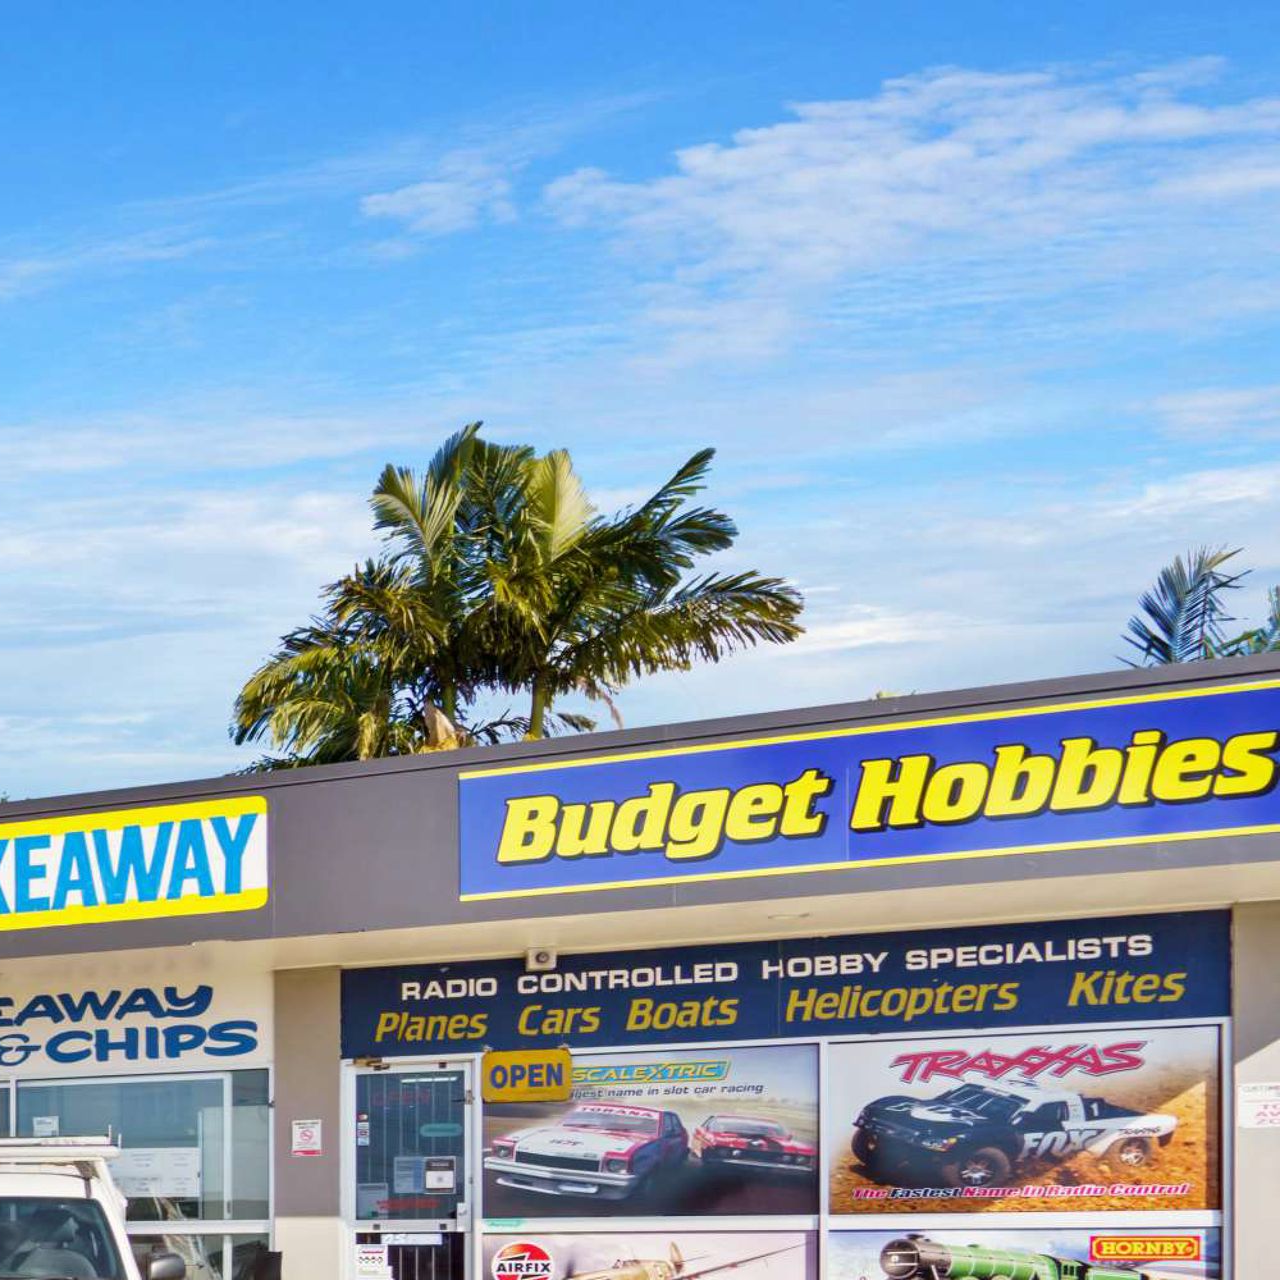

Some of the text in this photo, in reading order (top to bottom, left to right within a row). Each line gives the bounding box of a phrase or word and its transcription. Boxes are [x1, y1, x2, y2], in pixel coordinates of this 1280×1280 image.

[496, 729, 1279, 864] Budget Hobbies
[401, 934, 1154, 1001] RADIO CONTROLLED HOBBY SPECIALISTS
[375, 969, 1187, 1042] Planes Cars Boats Helicopters Kites
[45, 1020, 259, 1062] CHIPS
[572, 1060, 720, 1084] SCALEXTRIC
[890, 1040, 1148, 1084] TRAXXAS
[490, 1063, 563, 1089] OPEN
[607, 1088, 643, 1097] name
[647, 1086, 659, 1096] in
[663, 1085, 689, 1095] slot
[694, 1086, 716, 1094] car
[720, 1083, 764, 1095] racing
[853, 1188, 887, 1199] The
[890, 1187, 962, 1199] Fastest
[962, 1186, 1020, 1198] Name
[1044, 1184, 1106, 1197] Radio
[1109, 1182, 1191, 1196] Control
[1101, 1241, 1188, 1255] HORNBY
[496, 1262, 551, 1273] AIRFIX
